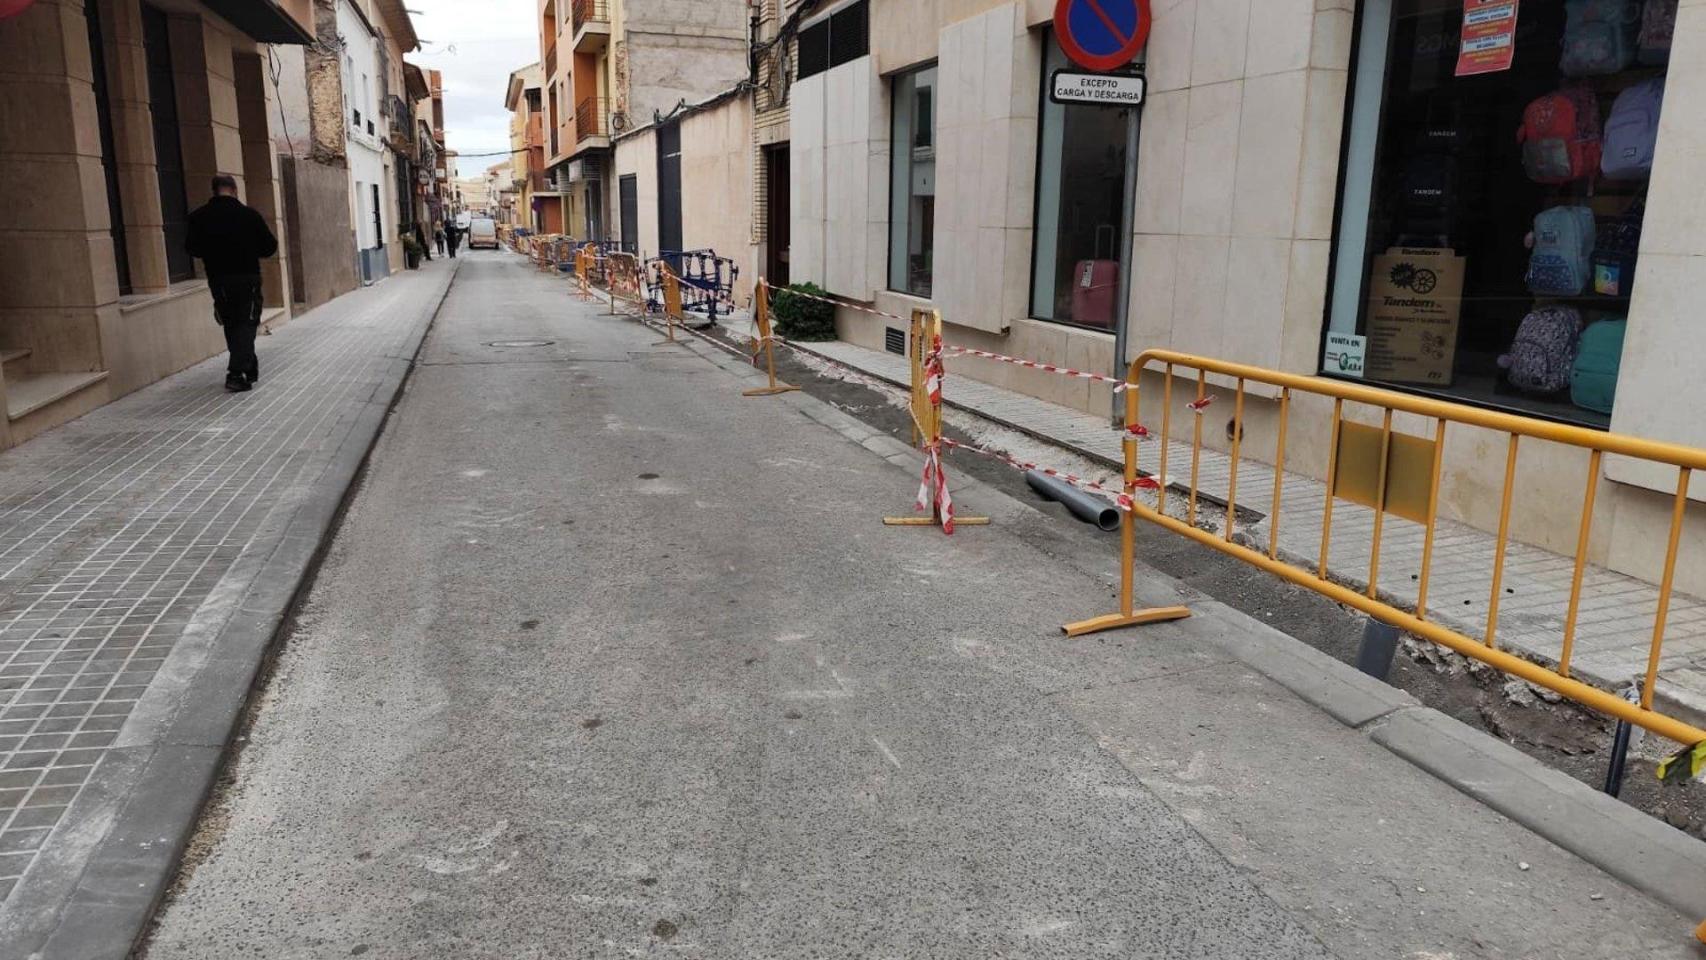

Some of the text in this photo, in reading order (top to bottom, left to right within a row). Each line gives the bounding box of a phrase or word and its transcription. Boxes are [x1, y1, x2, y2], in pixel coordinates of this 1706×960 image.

[1080, 78, 1118, 88] EXCEPTO
[1057, 88, 1085, 97] CARGA
[1095, 90, 1139, 100] DESCARGA
[1413, 188, 1442, 196] TANDEM
[1402, 248, 1440, 256] Tandem
[1383, 296, 1436, 308] Tandem
[1330, 336, 1360, 348] VENTA EN
